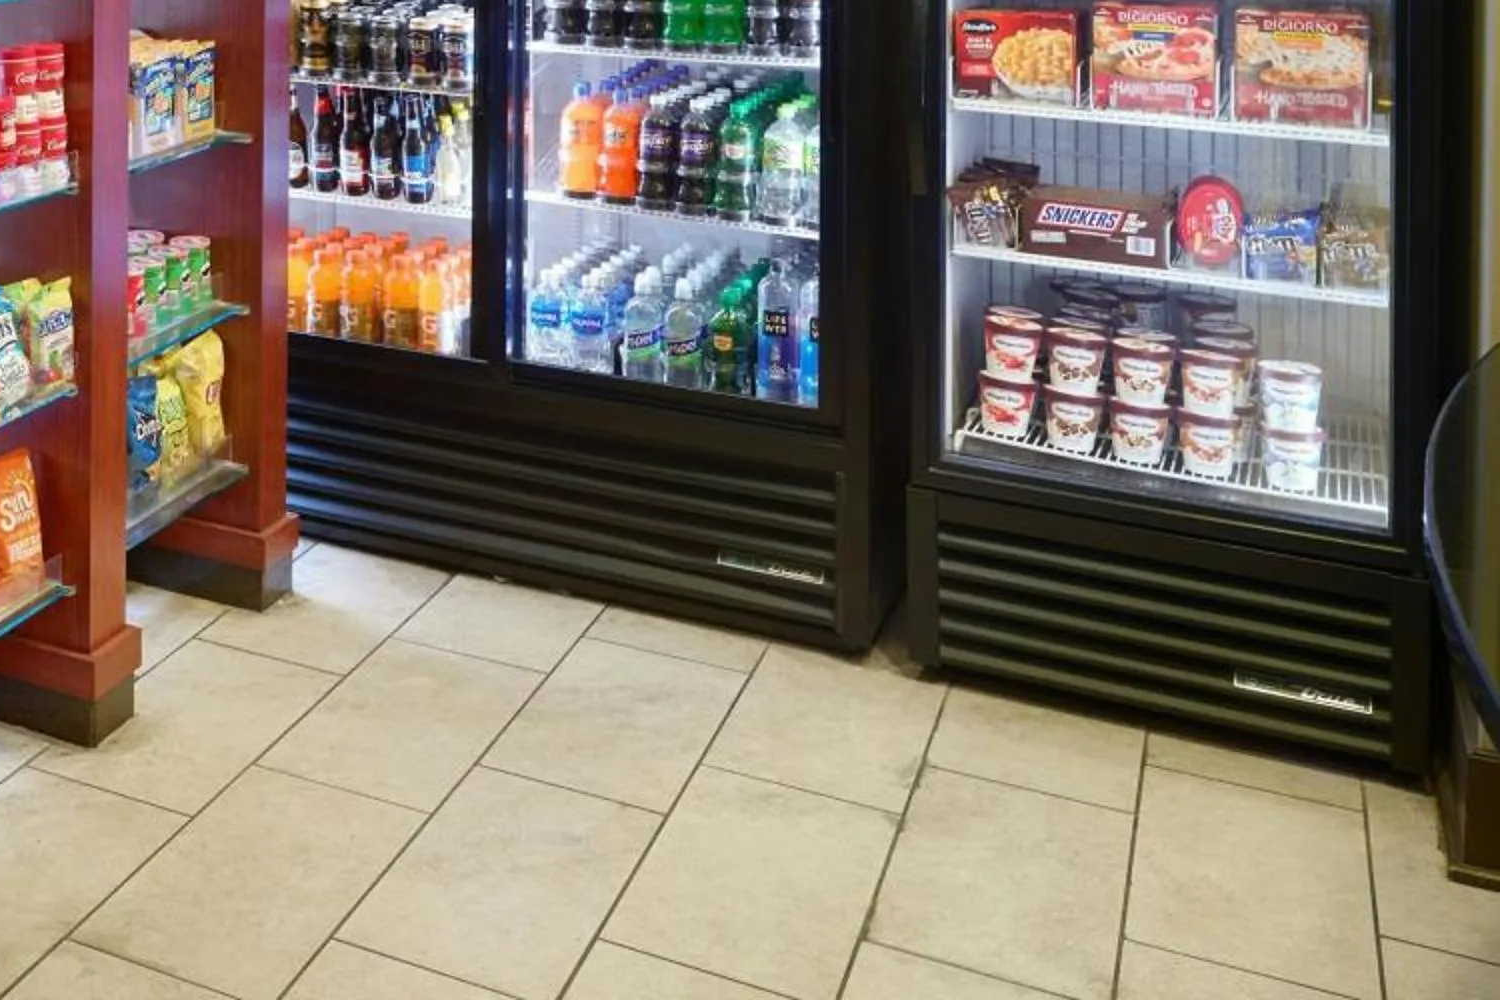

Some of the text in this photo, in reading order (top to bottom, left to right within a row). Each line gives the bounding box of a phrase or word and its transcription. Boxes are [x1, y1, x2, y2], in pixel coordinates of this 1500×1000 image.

[1117, 9, 1190, 26] DIGIORNO
[1262, 17, 1340, 35] DIGIORNO
[1041, 205, 1120, 231] SNICKERS
